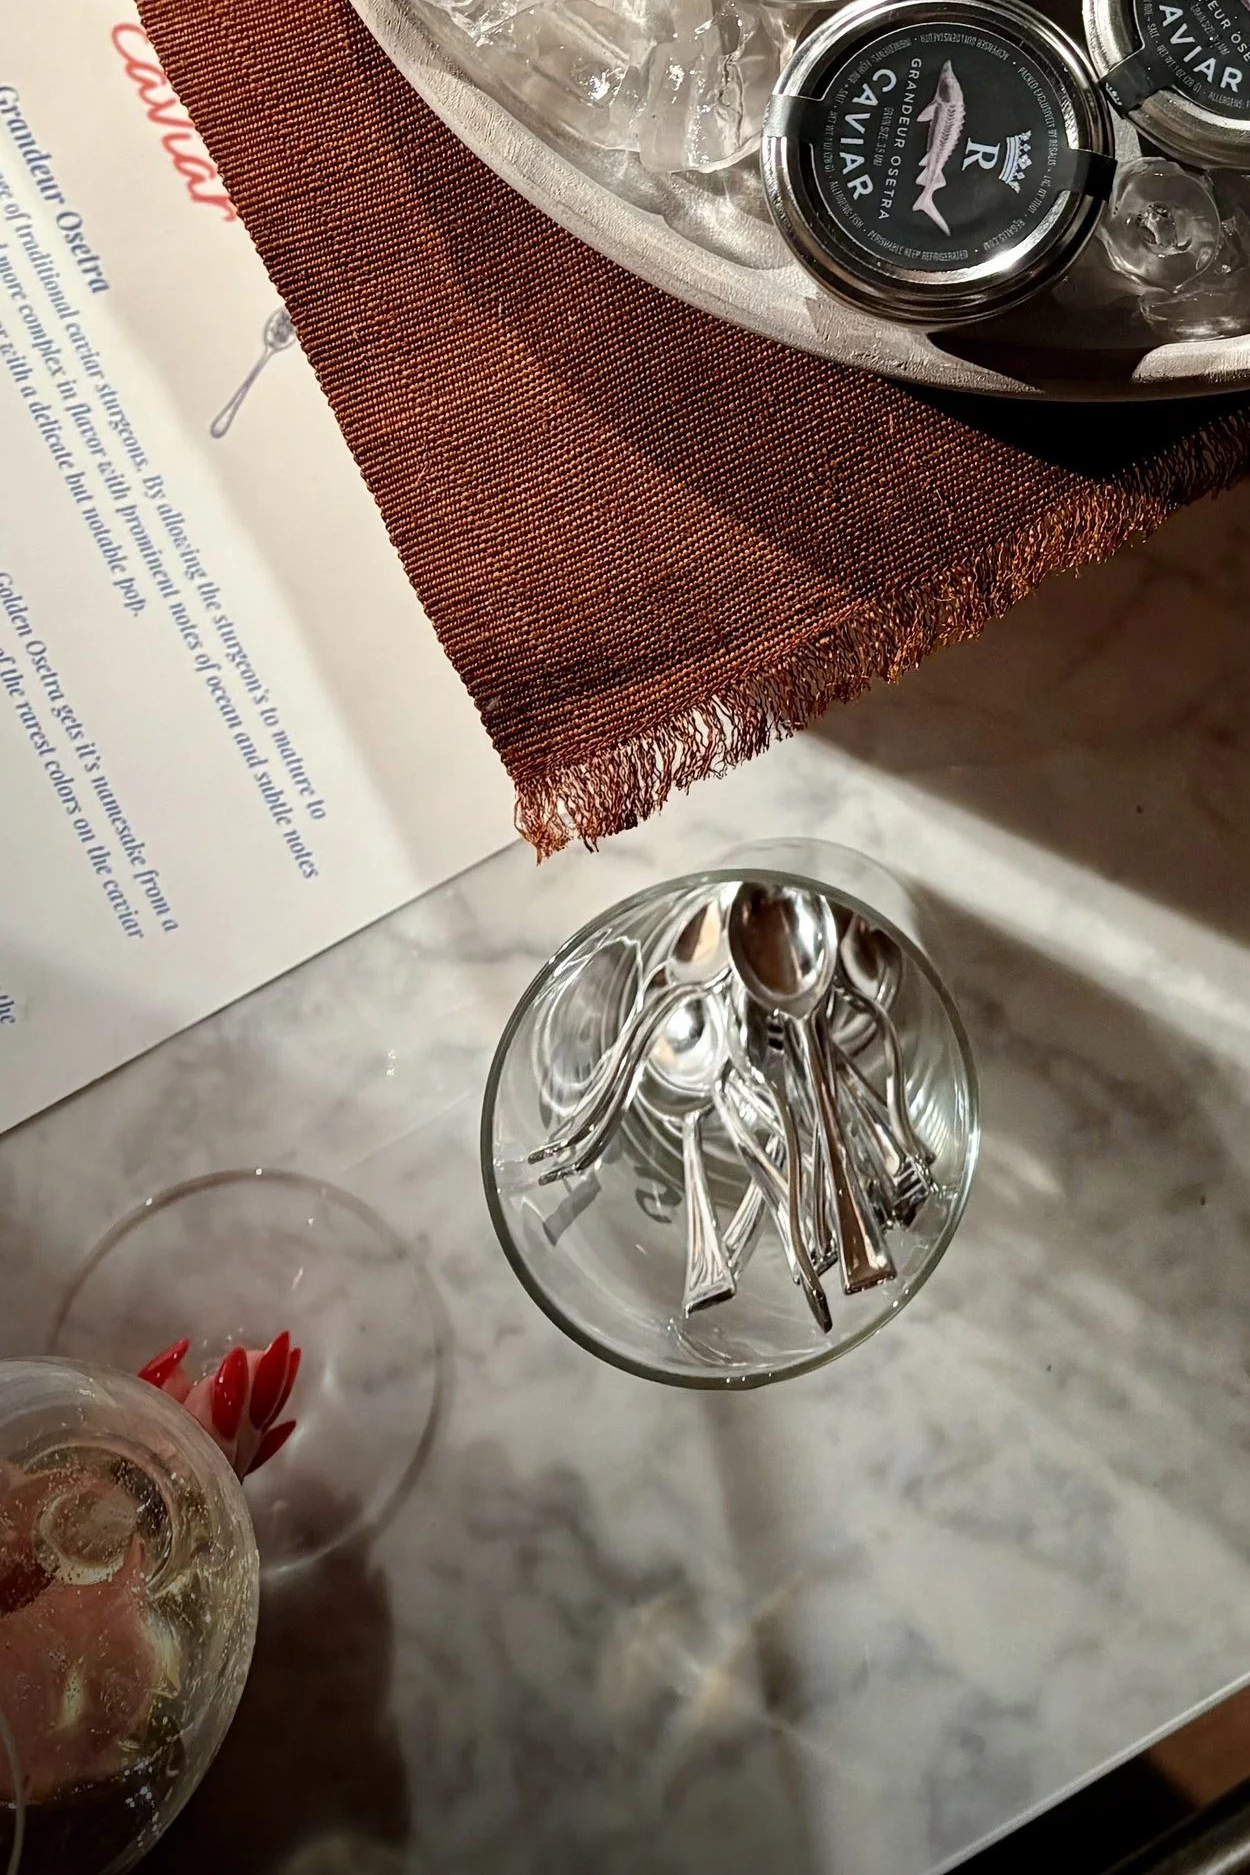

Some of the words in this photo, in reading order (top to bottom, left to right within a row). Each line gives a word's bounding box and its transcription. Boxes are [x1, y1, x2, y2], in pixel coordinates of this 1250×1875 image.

[893, 58, 922, 148] GRANDEUR
[839, 68, 897, 201] CAVIAR
[961, 137, 1000, 171] R
[0, 85, 65, 205] Grandeur
[55, 211, 110, 294] Osetra
[3, 203, 32, 221] of
[879, 156, 901, 220] OSETRA
[0, 256, 28, 301] more
[14, 224, 80, 320] traditional
[0, 342, 34, 383] with
[18, 304, 66, 377] complex
[64, 322, 105, 379] caviar
[19, 385, 38, 399] a
[55, 380, 78, 401] in
[28, 401, 75, 470] delicate
[64, 402, 107, 457] flavor
[95, 383, 149, 472] sturgeons.
[64, 471, 94, 504] but
[97, 460, 132, 501] with
[142, 474, 166, 500] By
[81, 507, 129, 574] notable
[115, 504, 181, 599] prominent
[156, 503, 207, 581] allowing
[112, 576, 147, 618] pop.
[196, 581, 222, 610] the
[168, 602, 203, 651] notes
[194, 653, 223, 672] of
[212, 614, 270, 705] sturgeon's
[205, 675, 243, 729] ocean
[259, 707, 280, 728] to
[233, 732, 269, 769] and
[271, 730, 315, 796] mature
[0, 667, 26, 698] the
[15, 701, 57, 757] rarest
[44, 760, 82, 815] colors
[72, 817, 96, 844] on
[86, 845, 113, 875] the
[102, 879, 144, 939] caviar
[25, 640, 65, 702] Osetra
[50, 704, 85, 741] gets
[74, 742, 102, 773] it's
[90, 775, 146, 866] namesake
[132, 869, 171, 916] from
[161, 918, 179, 933] a
[253, 771, 294, 826] subtle
[305, 799, 327, 820] to
[282, 829, 319, 879] notes
